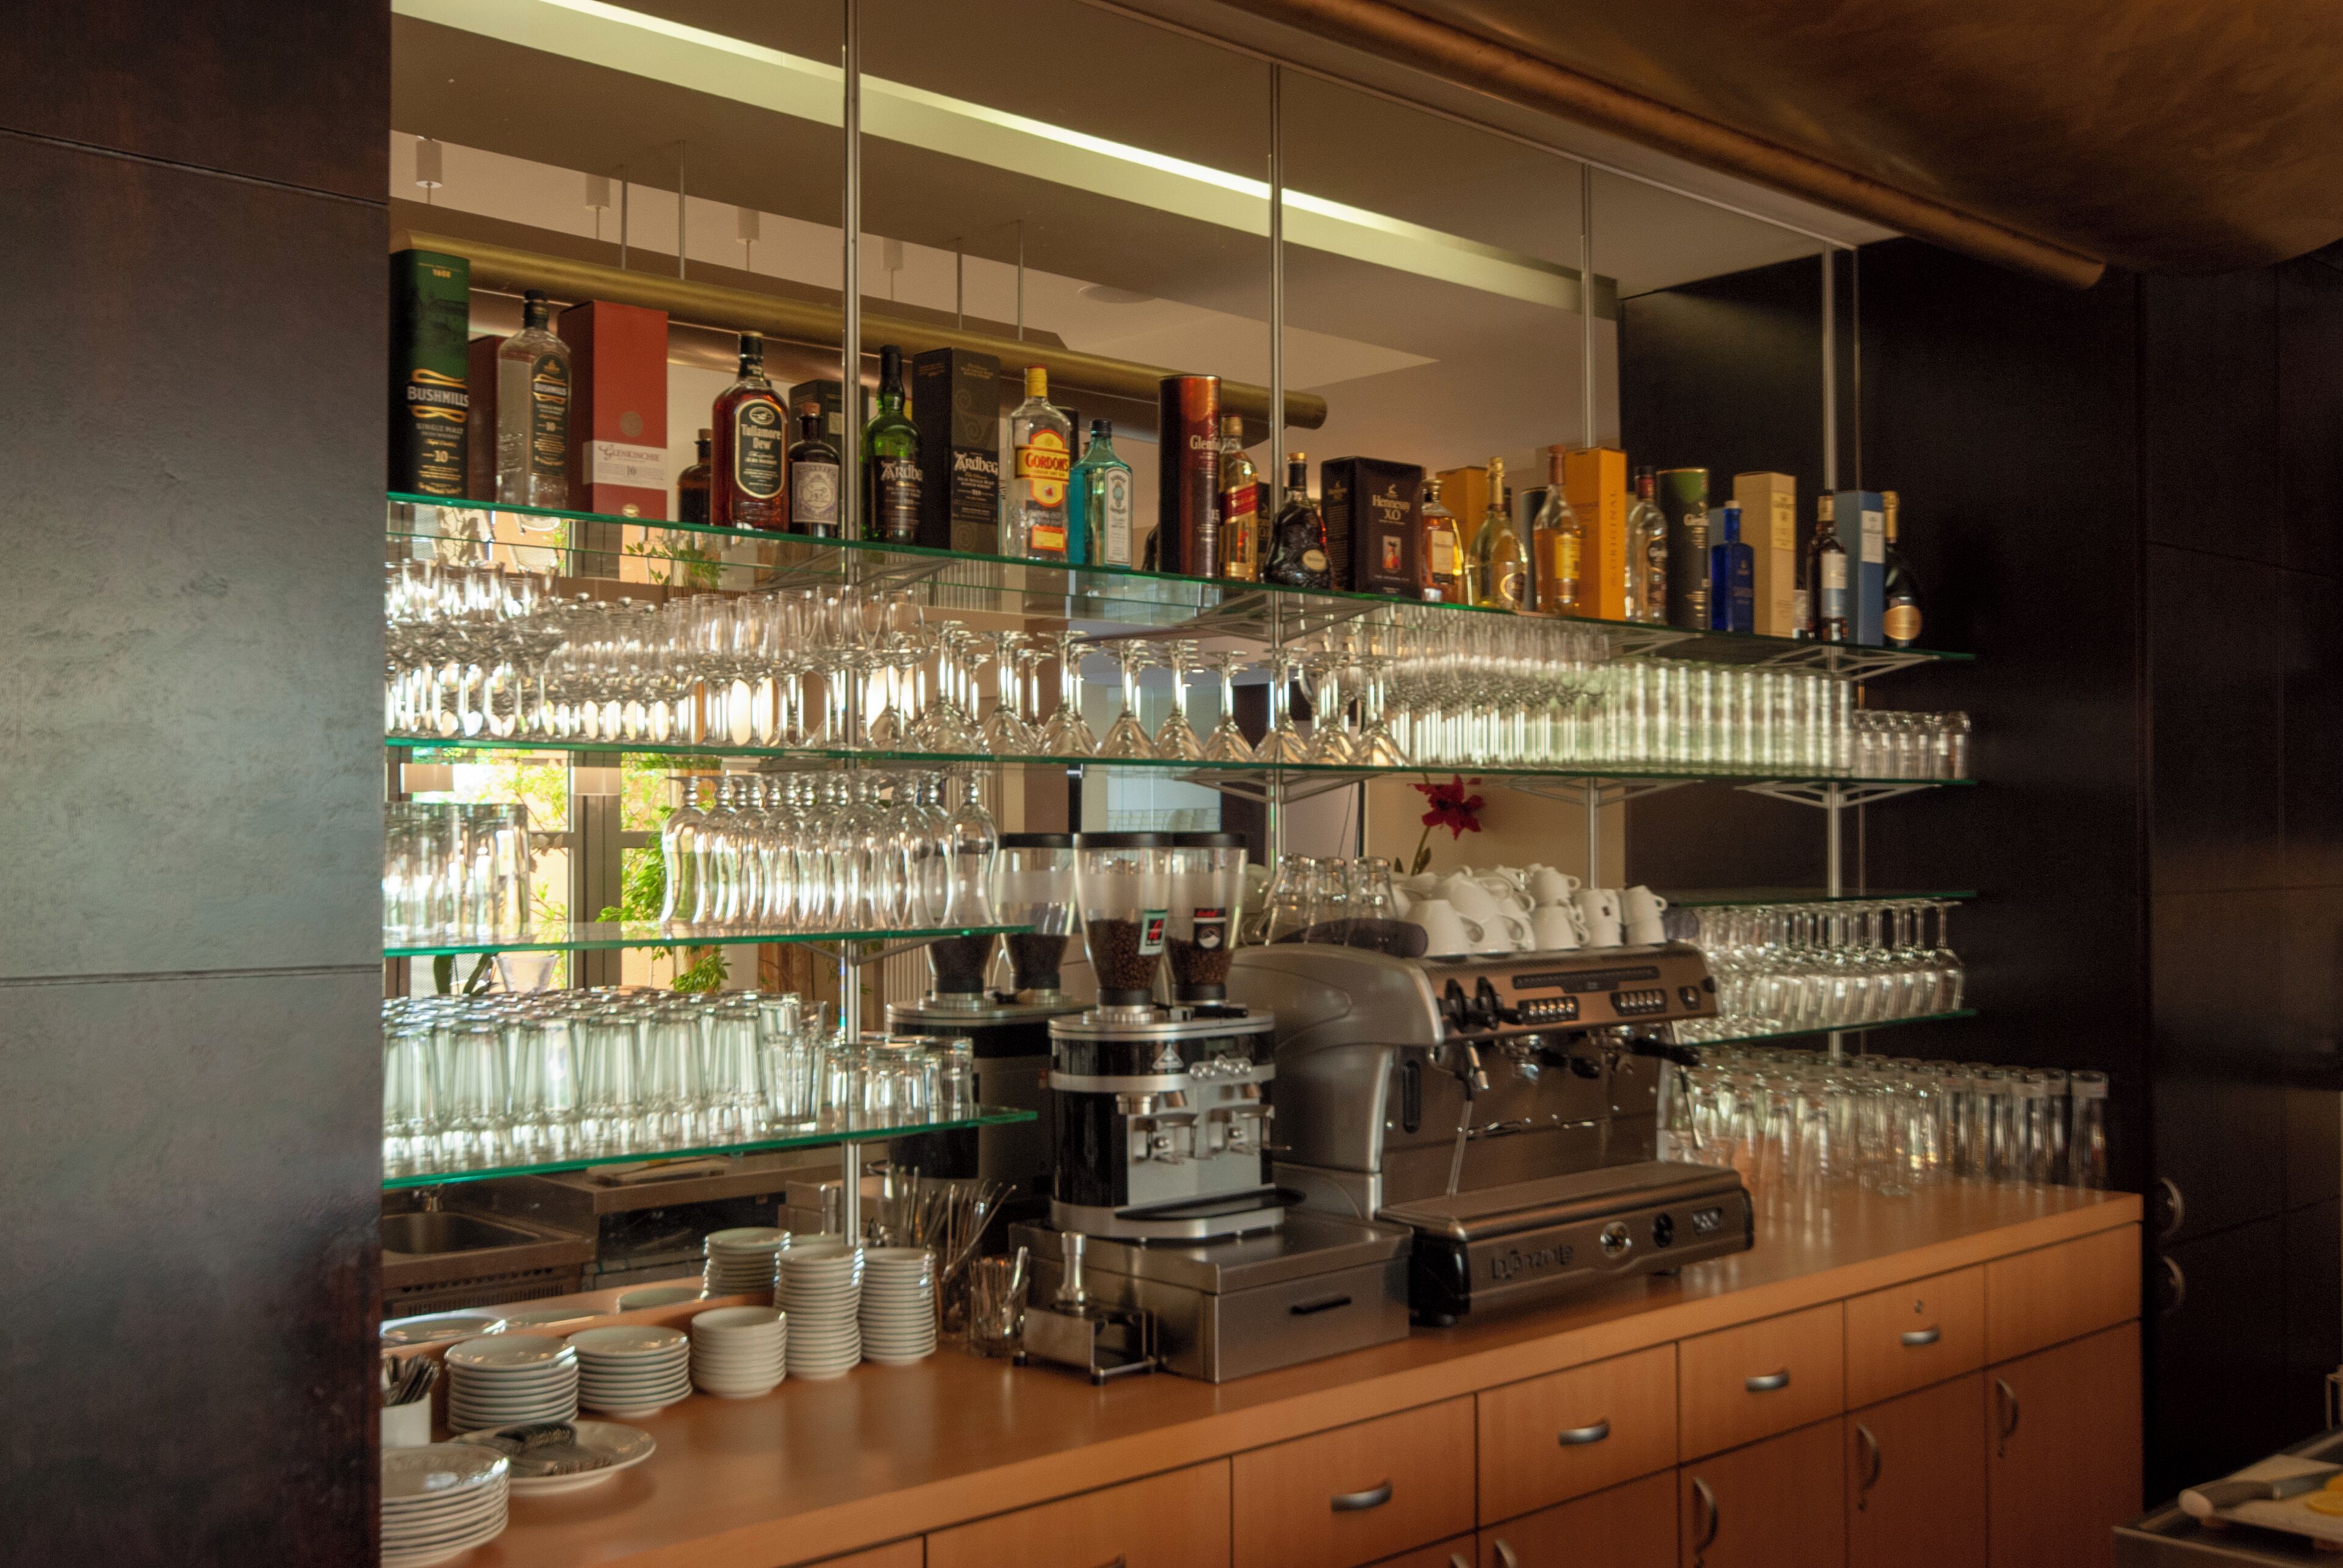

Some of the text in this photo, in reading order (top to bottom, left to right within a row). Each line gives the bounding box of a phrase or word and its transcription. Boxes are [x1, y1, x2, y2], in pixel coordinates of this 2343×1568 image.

[407, 386, 469, 407] BUSHMILLS
[433, 450, 448, 462] 10
[1372, 494, 1411, 512] Hennessy
